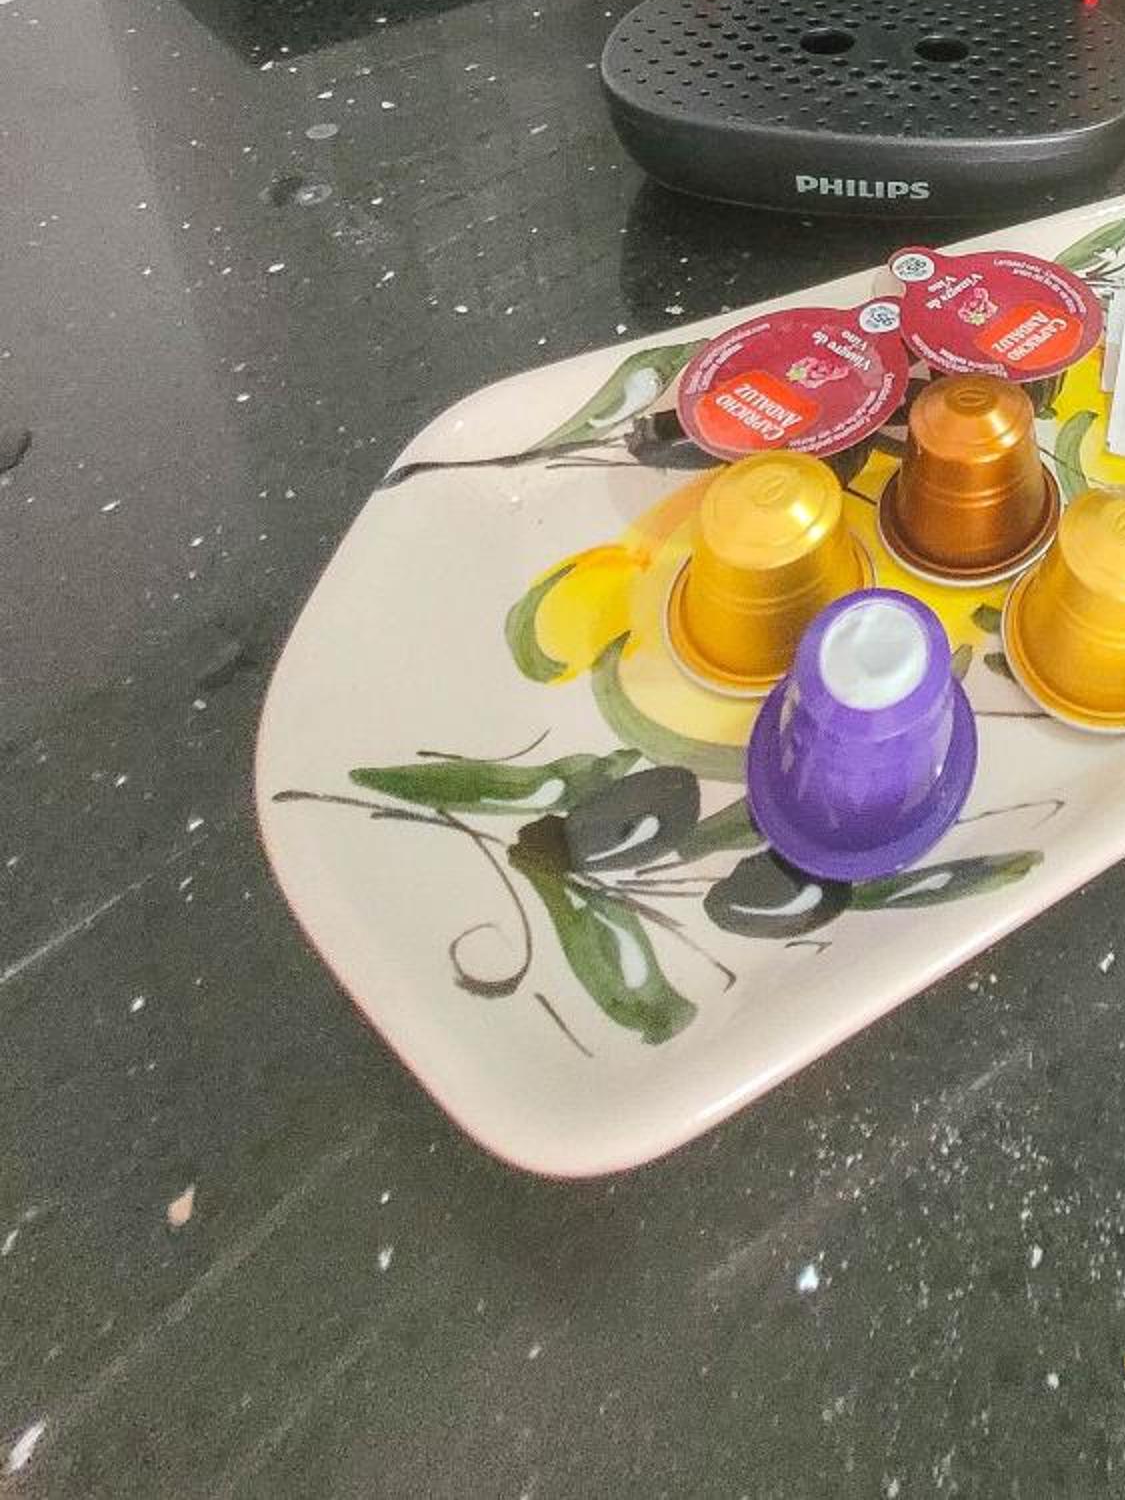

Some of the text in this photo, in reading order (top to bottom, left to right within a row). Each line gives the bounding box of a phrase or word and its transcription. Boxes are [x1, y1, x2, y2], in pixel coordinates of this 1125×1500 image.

[795, 175, 931, 199] PHILIPS
[927, 275, 957, 293] Vino
[841, 329, 868, 351] Vino
[991, 310, 1049, 352] ANDALUZ
[1007, 317, 1067, 361] CAPRICHO
[827, 341, 872, 371] Vinagre
[715, 394, 785, 441] CAPRICHO
[733, 383, 803, 427] ANDALUZ
